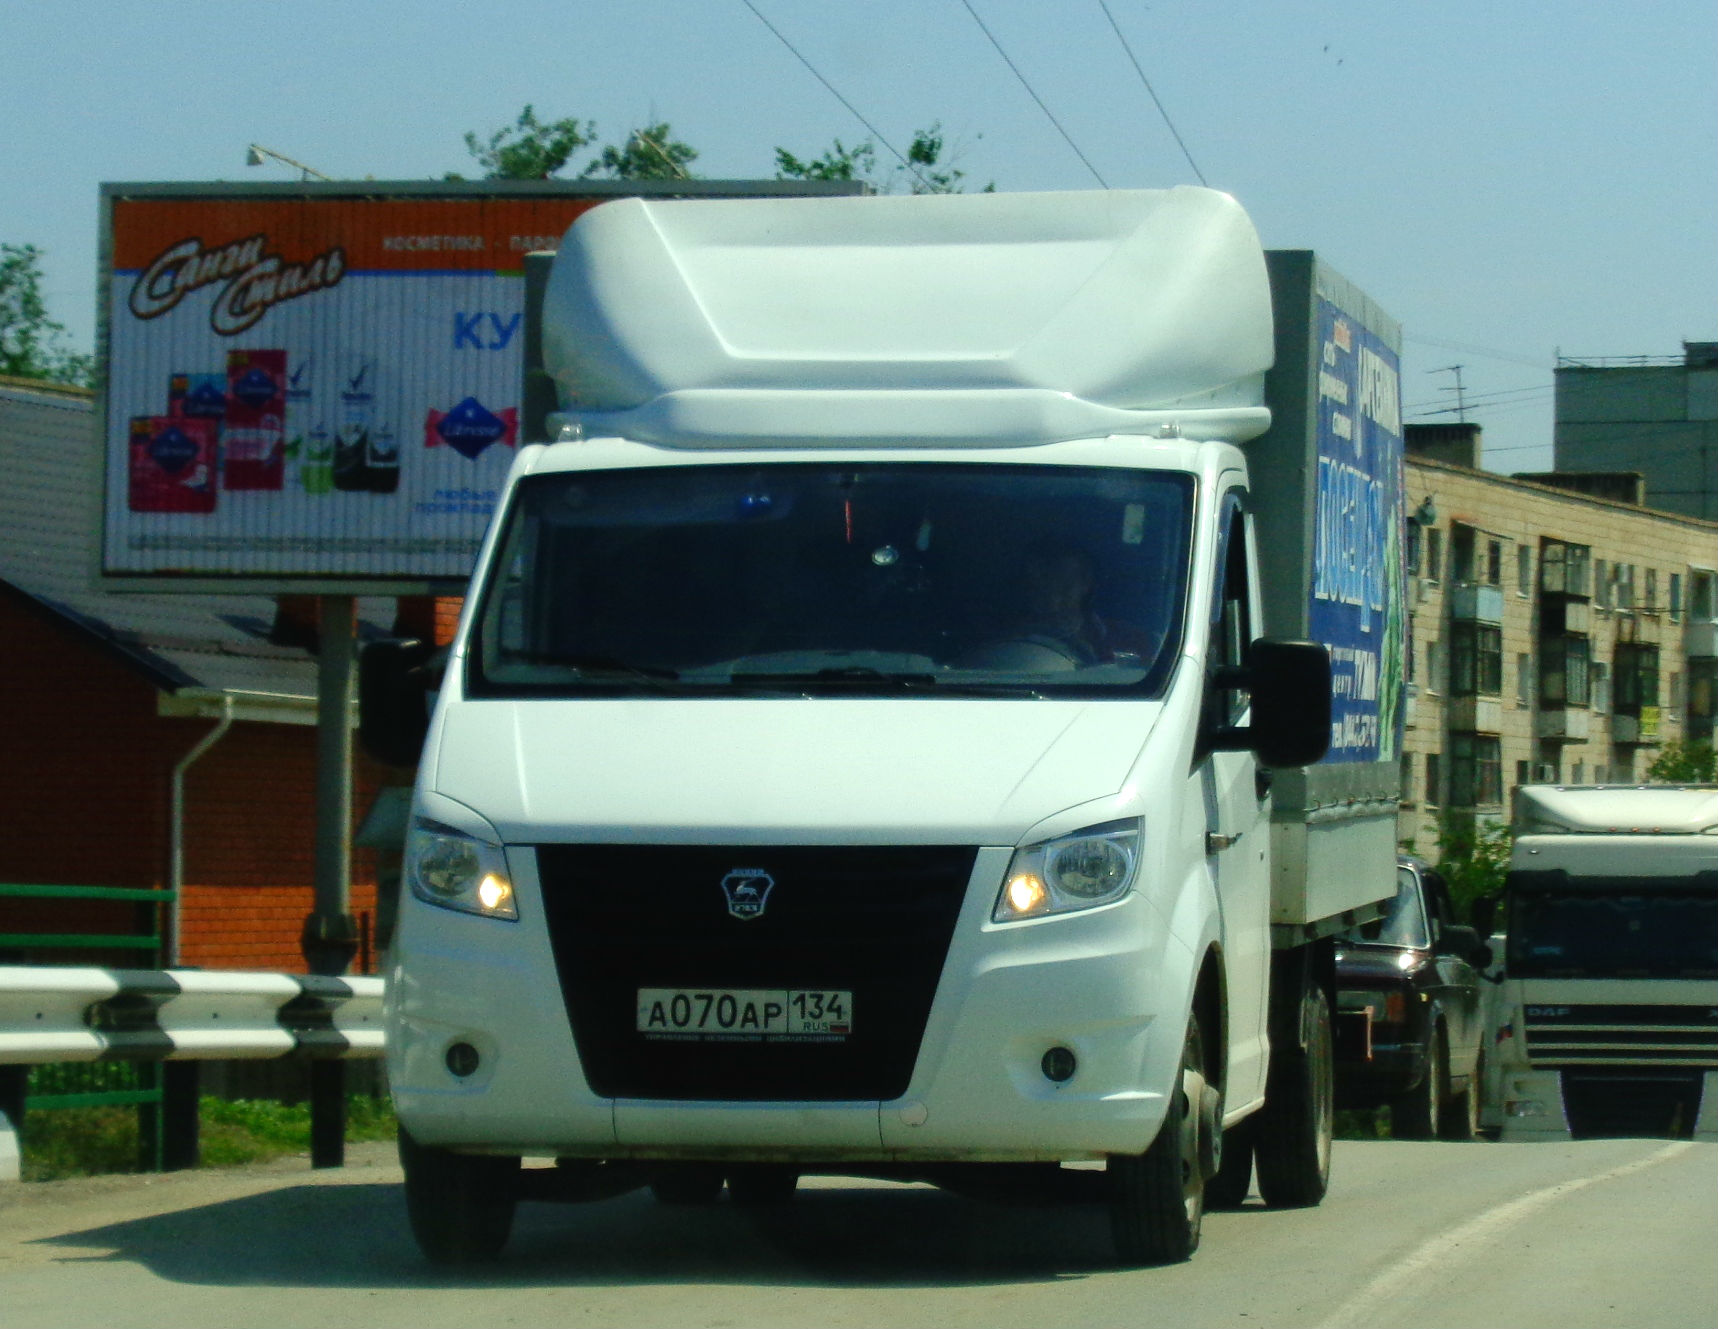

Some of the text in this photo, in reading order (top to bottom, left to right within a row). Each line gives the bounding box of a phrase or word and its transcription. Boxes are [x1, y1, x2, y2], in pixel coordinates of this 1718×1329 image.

[382, 235, 485, 251] КОСМЕТИКА
[210, 247, 346, 335] Стиль
[793, 993, 843, 1020] 134
[1528, 1007, 1569, 1016] DAF
[803, 1022, 829, 1032] RUS
